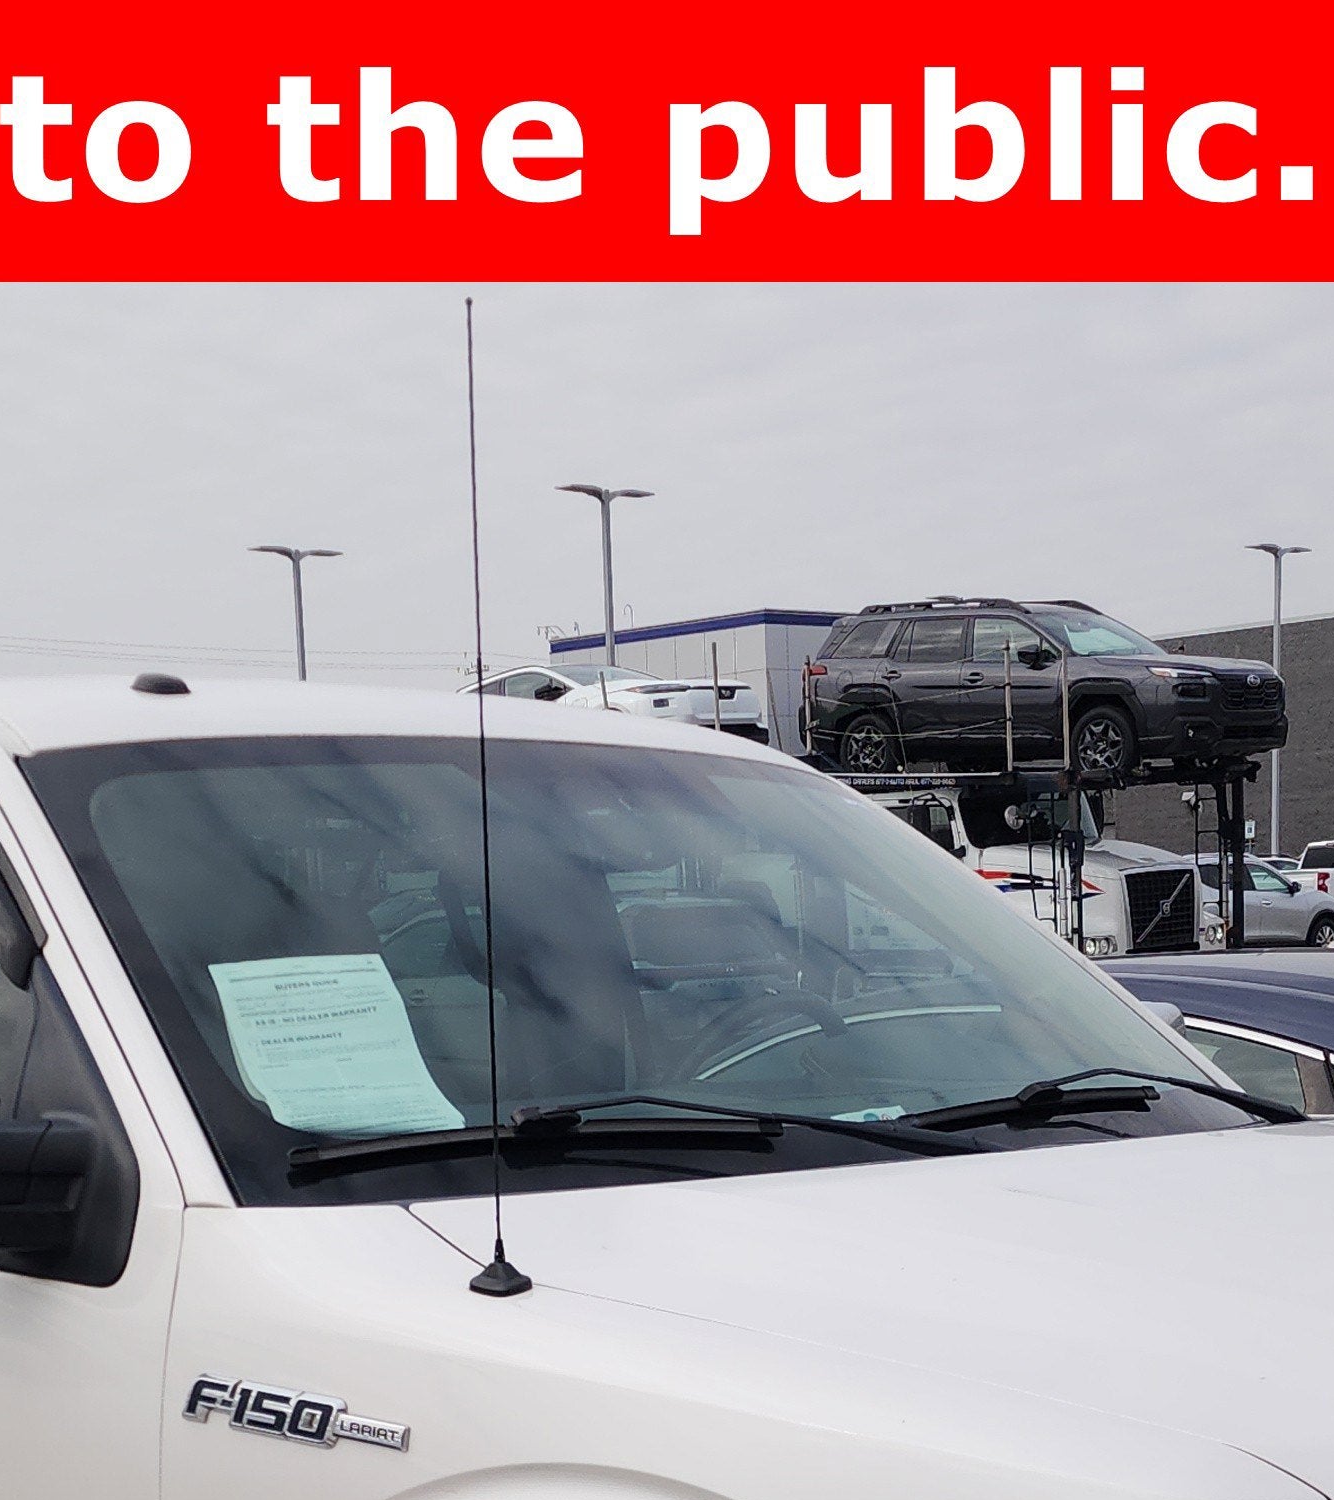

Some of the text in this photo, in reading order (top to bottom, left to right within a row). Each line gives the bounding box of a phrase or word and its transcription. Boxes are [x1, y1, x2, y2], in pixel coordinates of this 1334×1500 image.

[331, 1006, 377, 1018] WARRANTY
[183, 1376, 401, 1445] F-150 LARIAT
